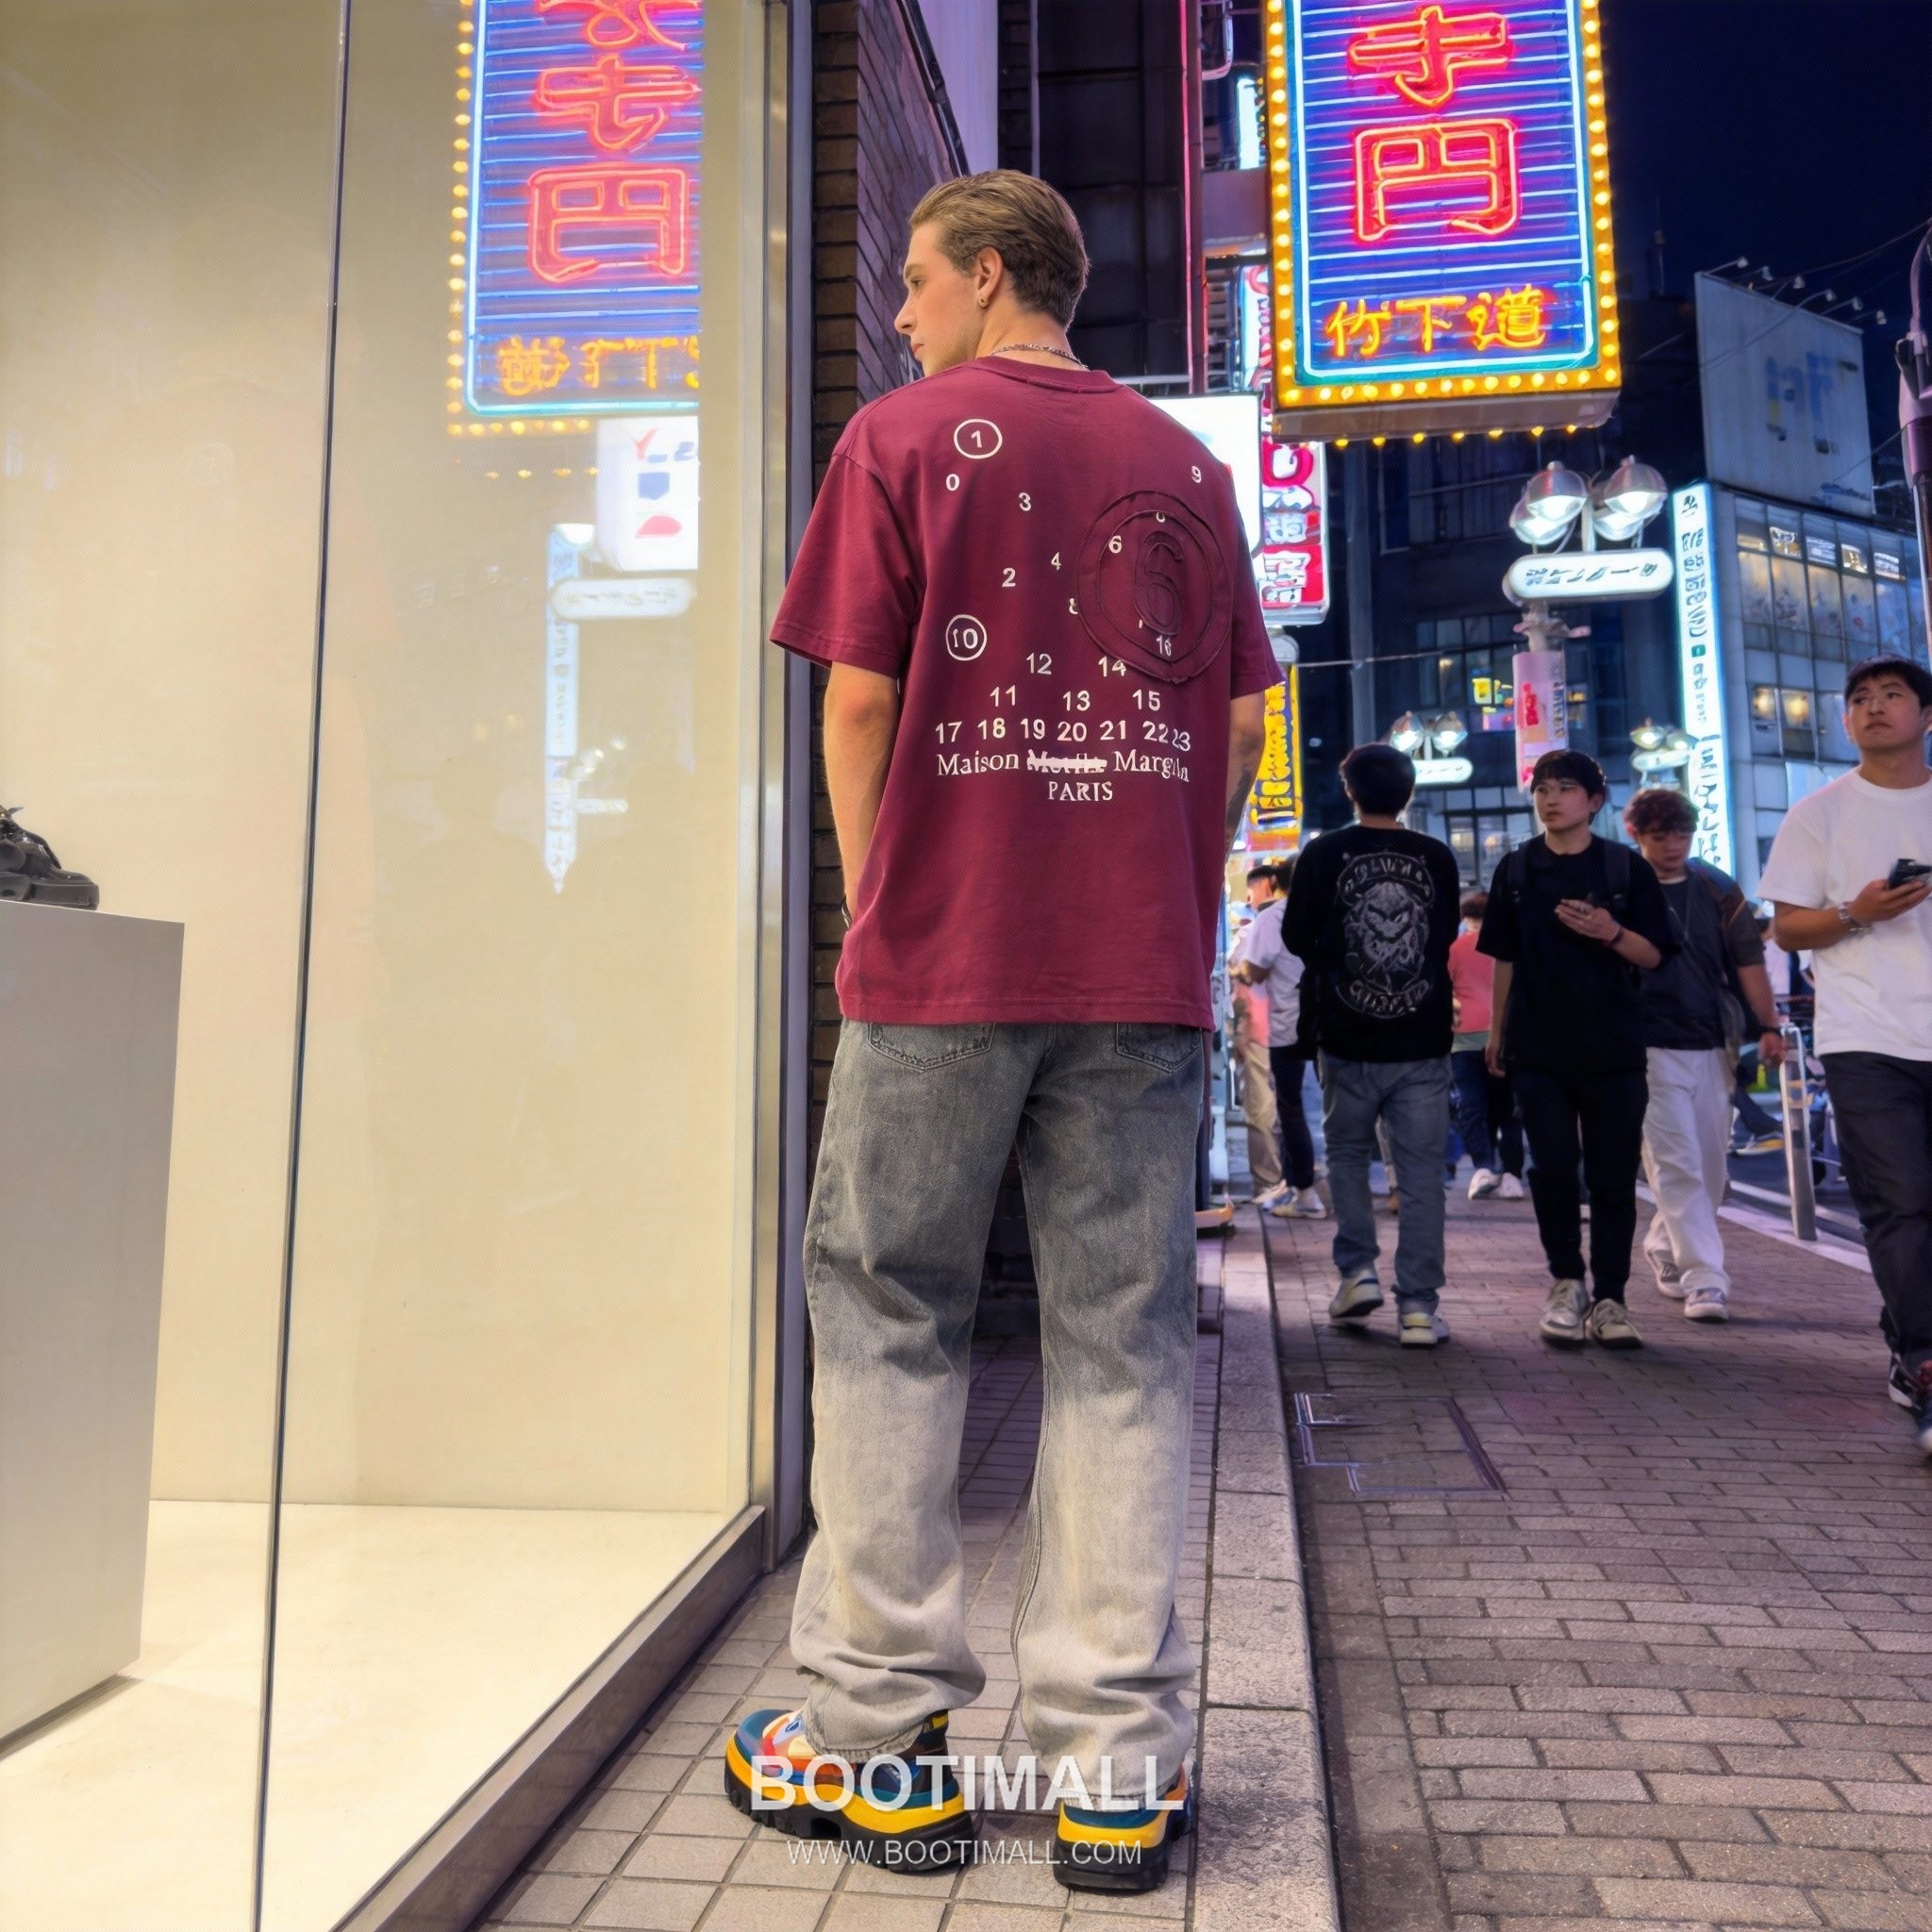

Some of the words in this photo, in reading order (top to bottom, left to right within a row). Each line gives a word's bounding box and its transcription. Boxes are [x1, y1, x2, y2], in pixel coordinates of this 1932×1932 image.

[945, 473, 960, 491] 0
[1191, 465, 1202, 484] 9
[1018, 492, 1032, 511] 3
[1108, 535, 1123, 554] 6
[1050, 552, 1062, 571] 4
[1002, 567, 1017, 588] 2
[952, 628, 978, 649] 10
[1026, 653, 1053, 675] 12
[1098, 656, 1127, 677] 14
[990, 685, 1016, 707] 11
[1062, 690, 1091, 711] 13
[1132, 689, 1161, 711] 15
[935, 721, 962, 744] 17
[977, 718, 1007, 740] 18
[1020, 718, 1046, 741] 19
[1057, 721, 1088, 742] 20
[1099, 720, 1127, 741] 21
[1142, 721, 1169, 744] 22
[1172, 728, 1191, 752] 23
[937, 750, 1020, 775] Maison
[1048, 781, 1113, 802] PARIS
